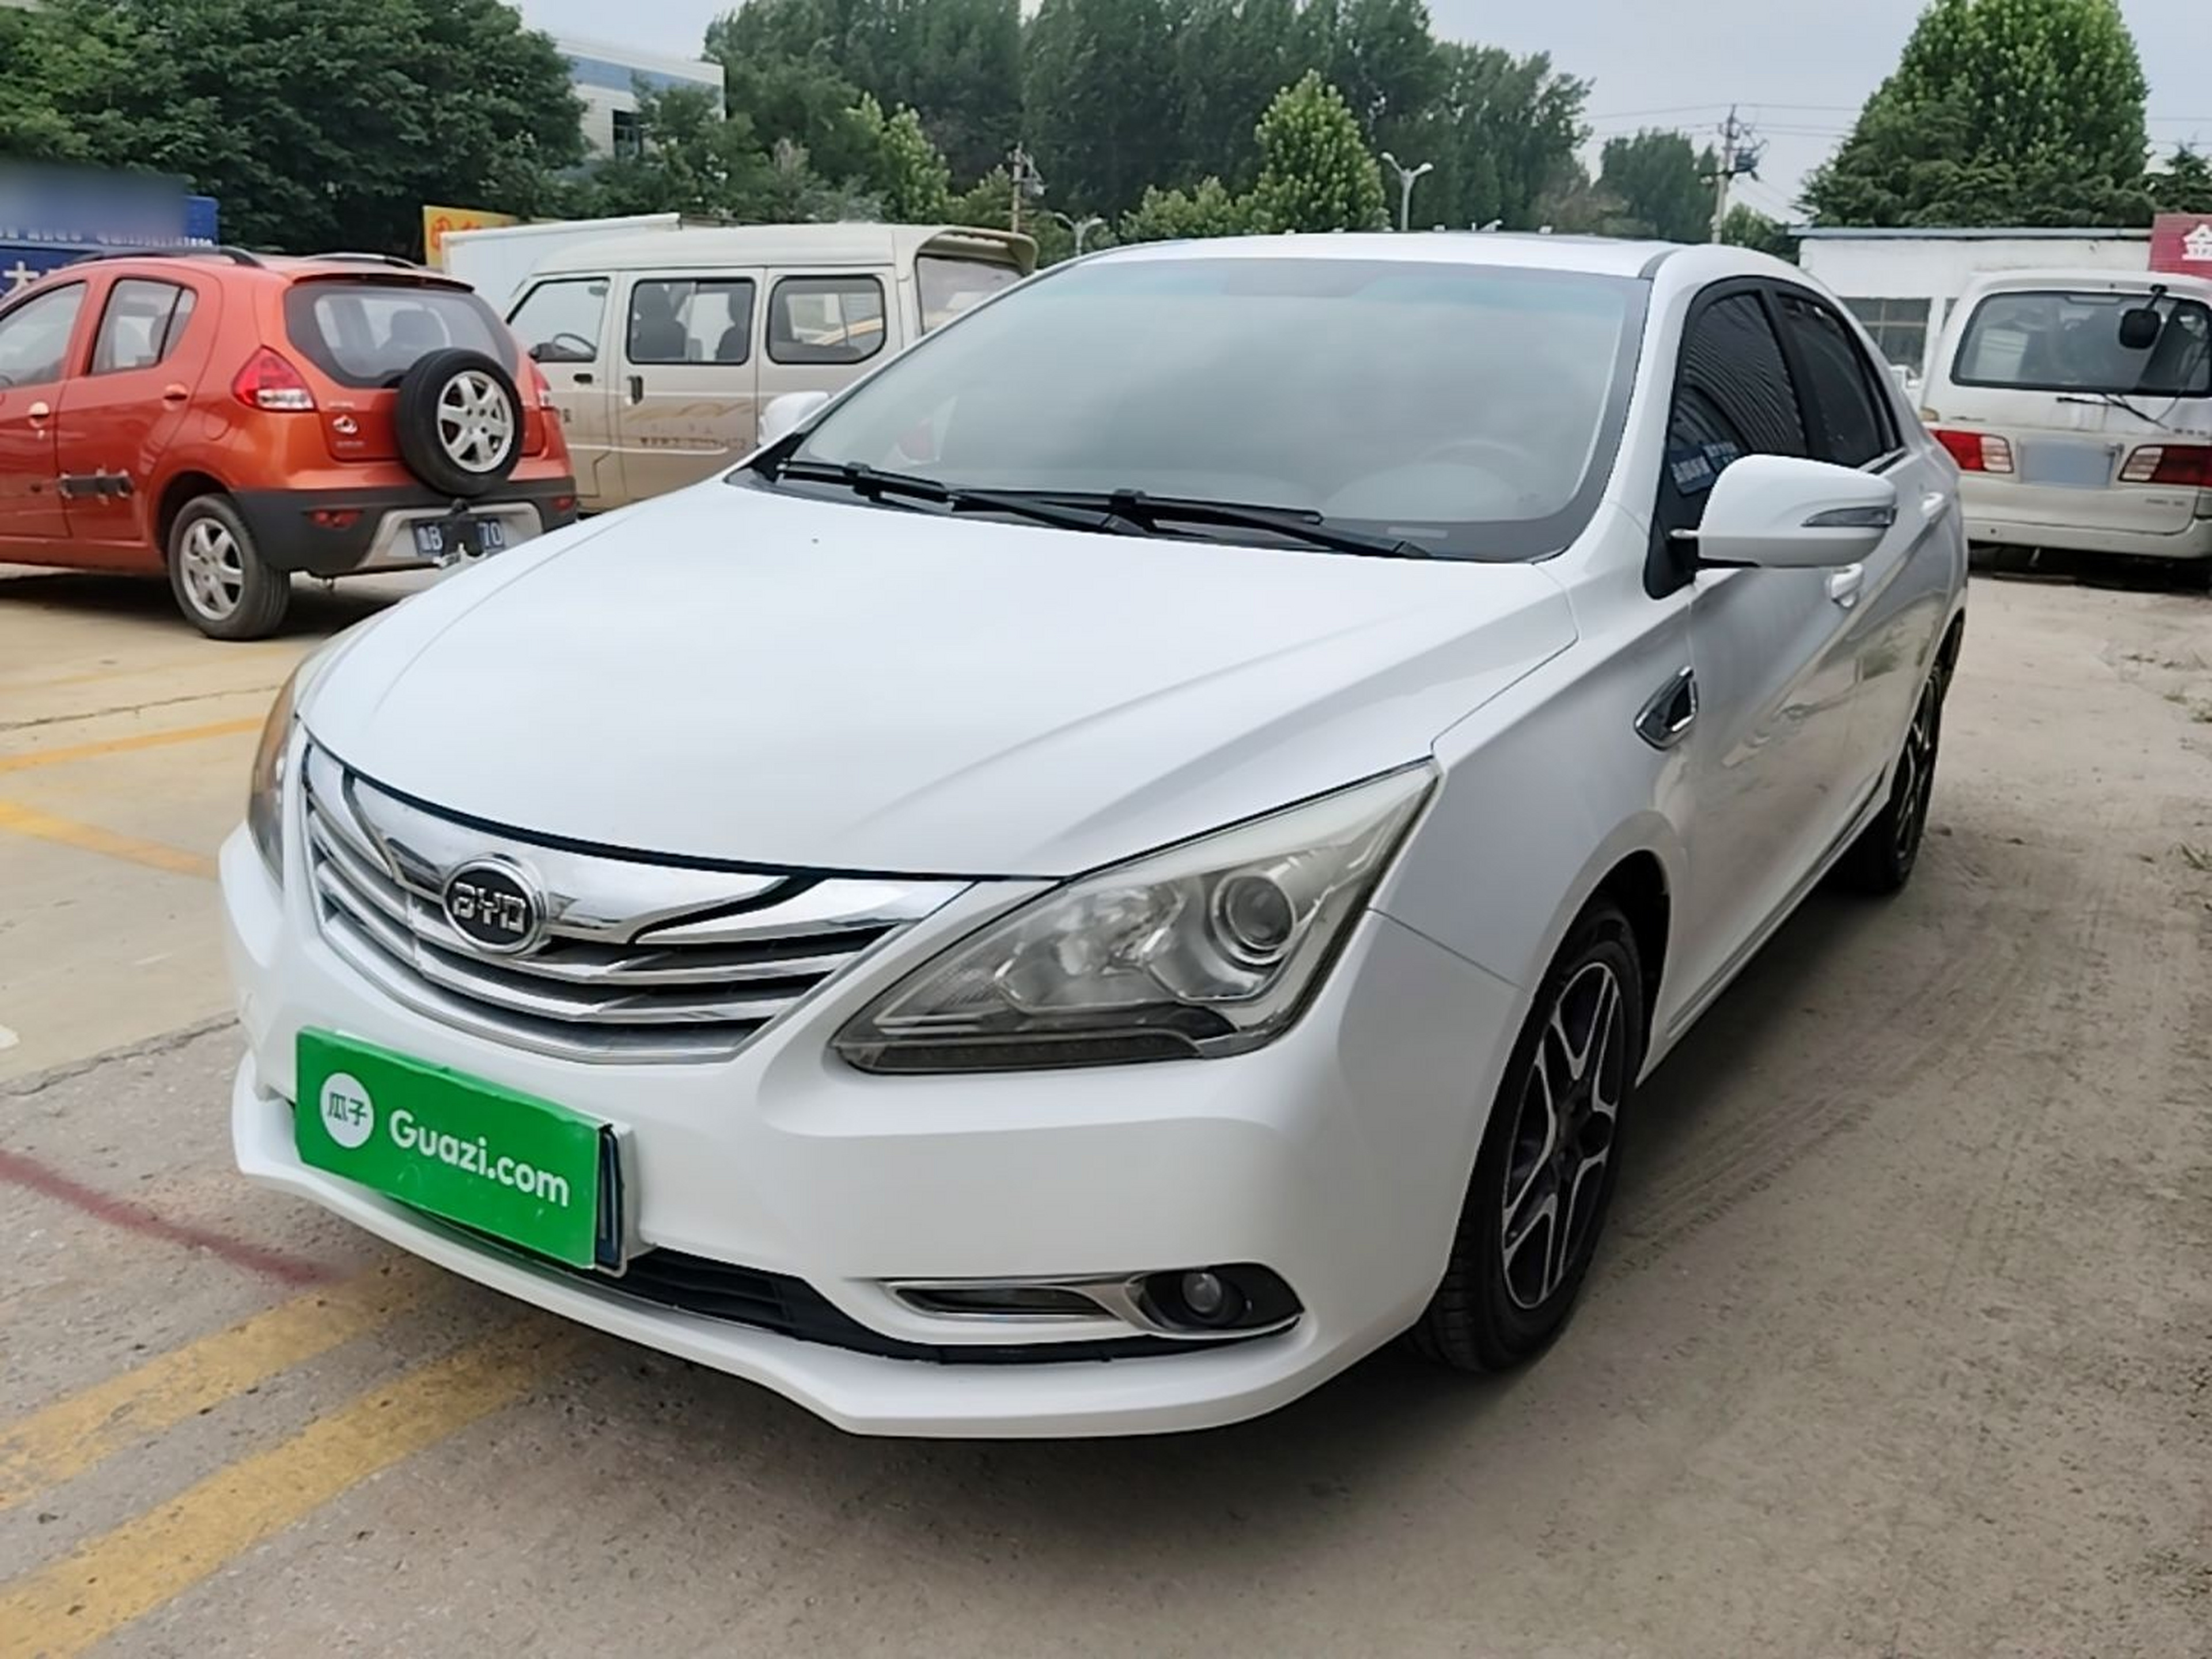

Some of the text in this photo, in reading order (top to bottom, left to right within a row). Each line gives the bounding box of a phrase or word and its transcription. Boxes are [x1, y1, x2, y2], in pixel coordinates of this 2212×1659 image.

[452, 881, 527, 934] BYD
[327, 1091, 570, 1207] 瓜子 Guazi.com
